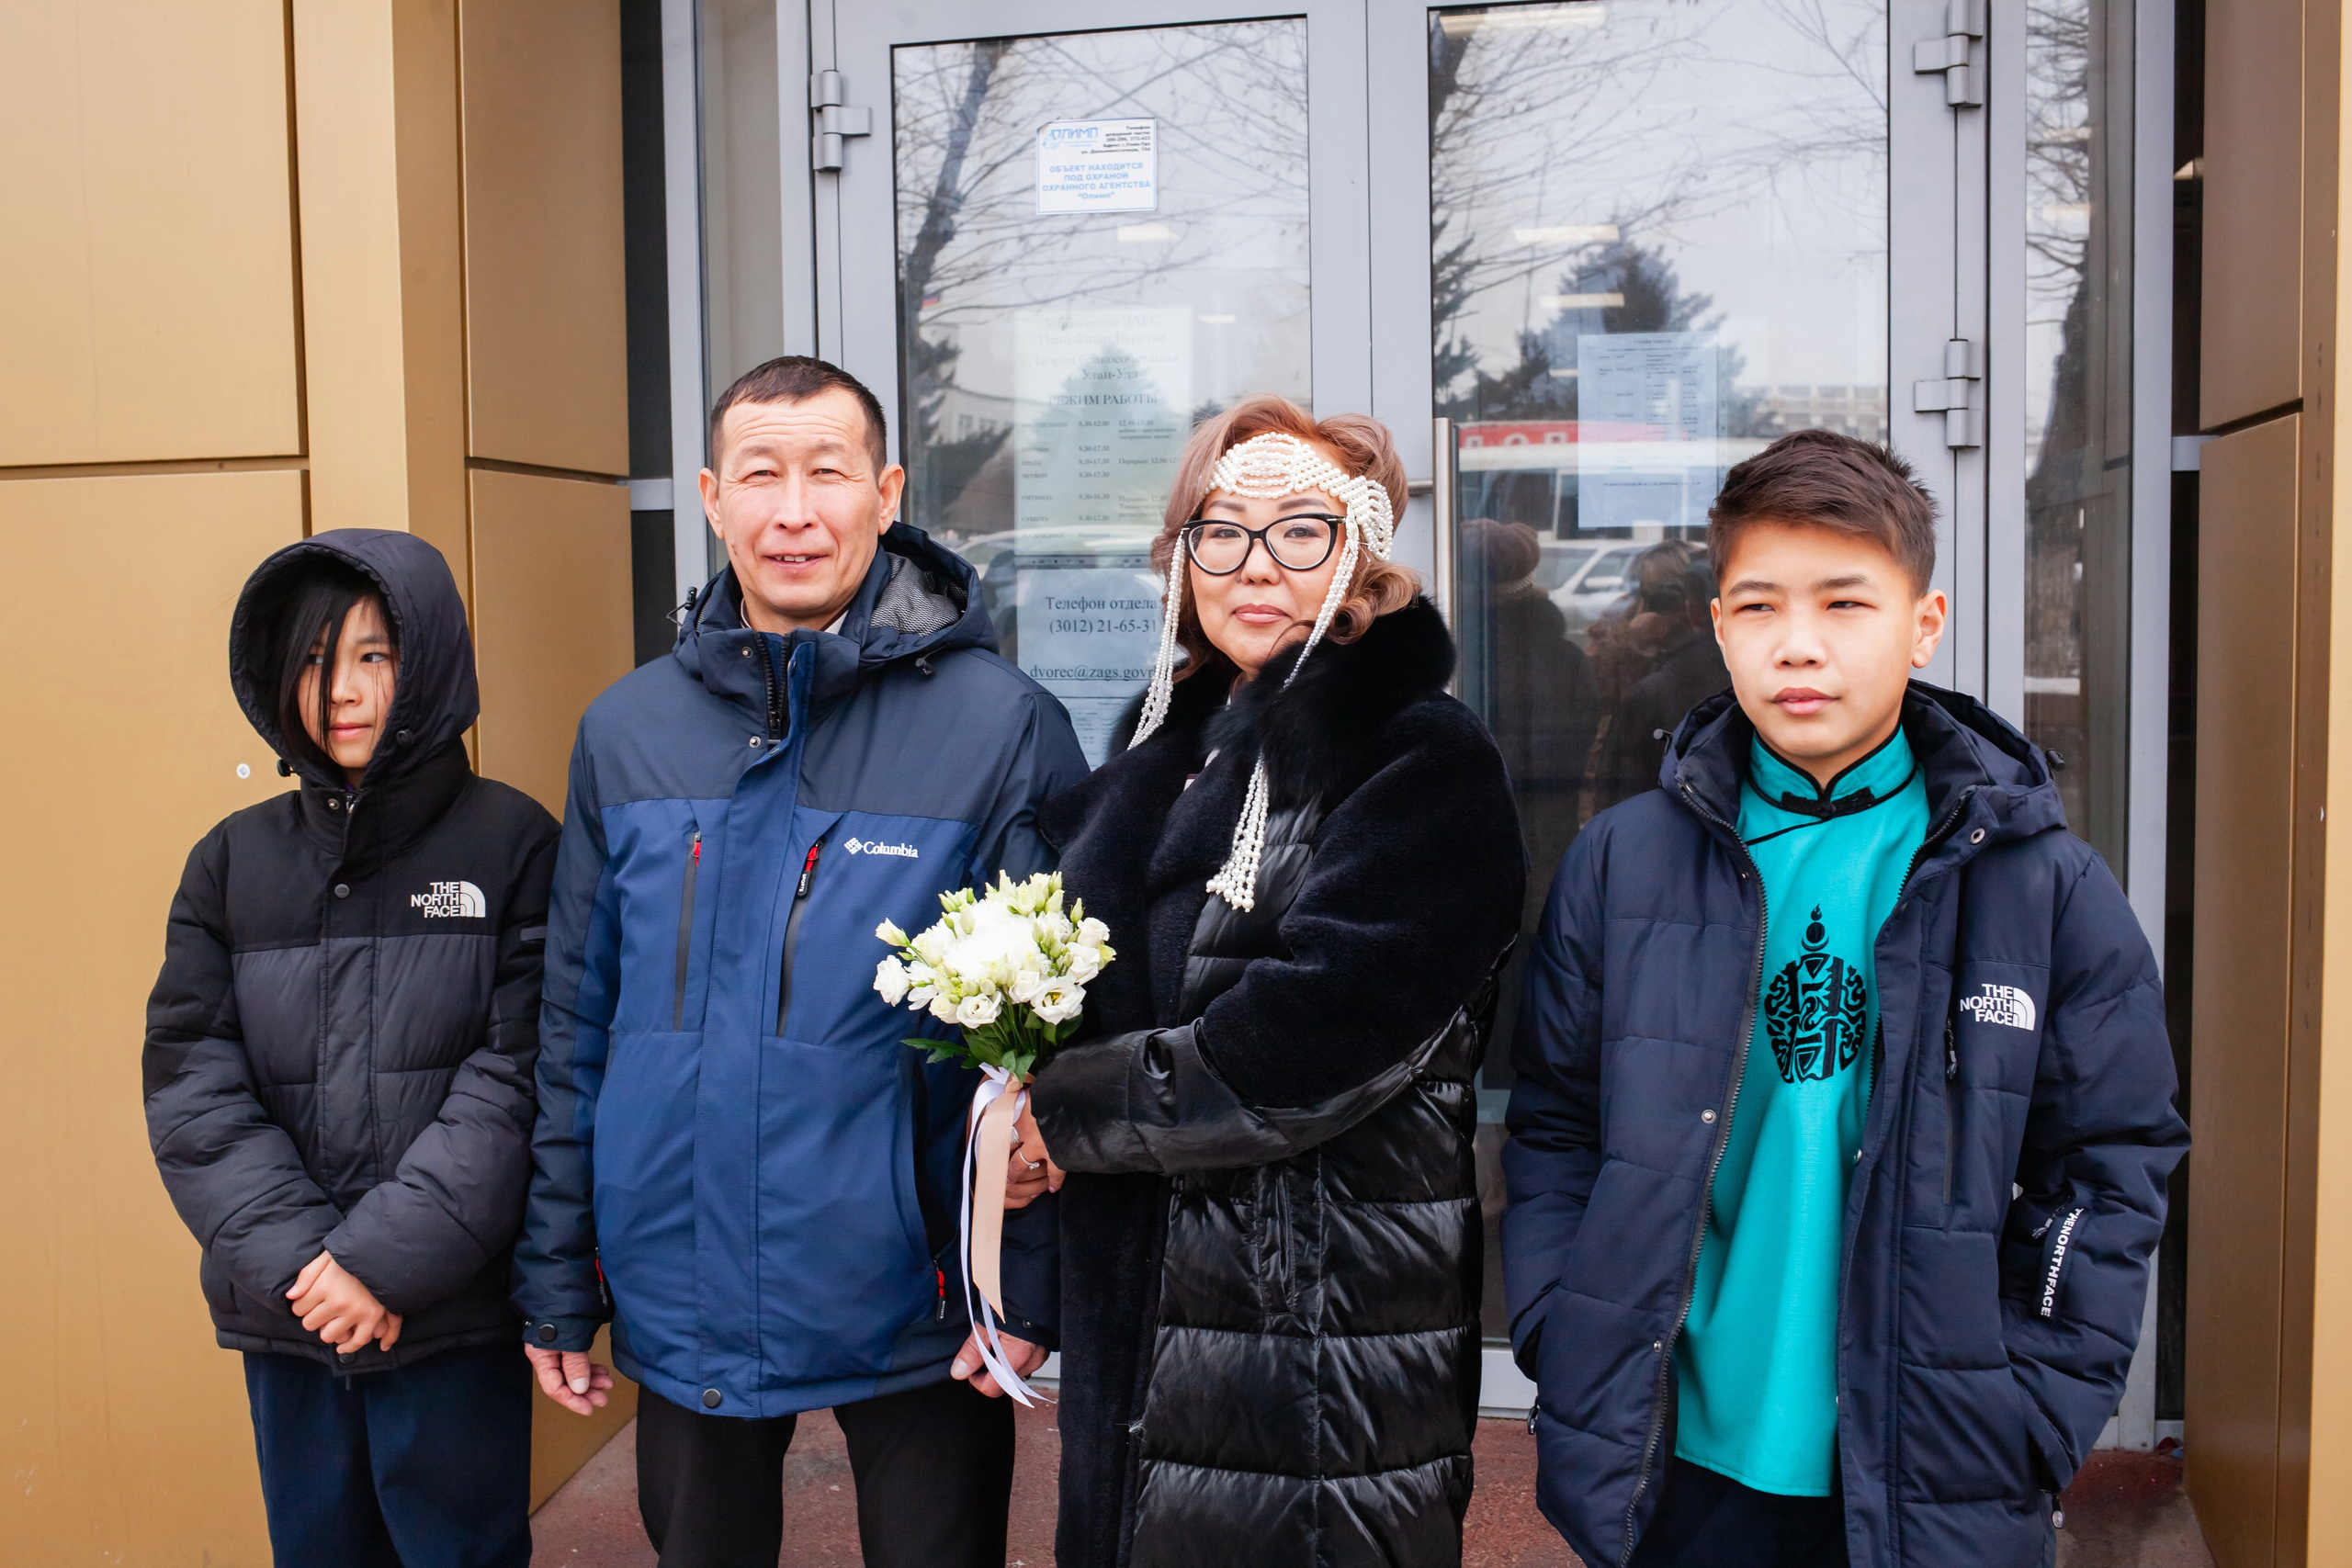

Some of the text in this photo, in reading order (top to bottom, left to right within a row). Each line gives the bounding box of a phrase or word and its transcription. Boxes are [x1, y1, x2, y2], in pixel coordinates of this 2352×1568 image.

[1088, 162, 1143, 171] НАХОДИТСЯ
[1085, 172, 1129, 181] ОХРАНОЙ
[1042, 181, 1151, 192] ОХРАННОГО АГЕНТСТВА
[1123, 314, 1162, 327] ЗАГС
[1081, 367, 1139, 381] Улан-Удэ
[1102, 393, 1159, 405] РАБОТЫ
[1045, 596, 1161, 614] Телефон отдела:
[1049, 619, 1157, 636] (3012) 21-65-31
[1030, 664, 1156, 682] dvorec@zags.govr
[864, 841, 919, 858] Columbia
[429, 882, 459, 894] THE
[411, 893, 459, 907] NORTH
[424, 905, 459, 918] FACE
[1981, 983, 2014, 999] THE
[1960, 996, 2013, 1011] NORTH
[1974, 1009, 2013, 1026] FACE
